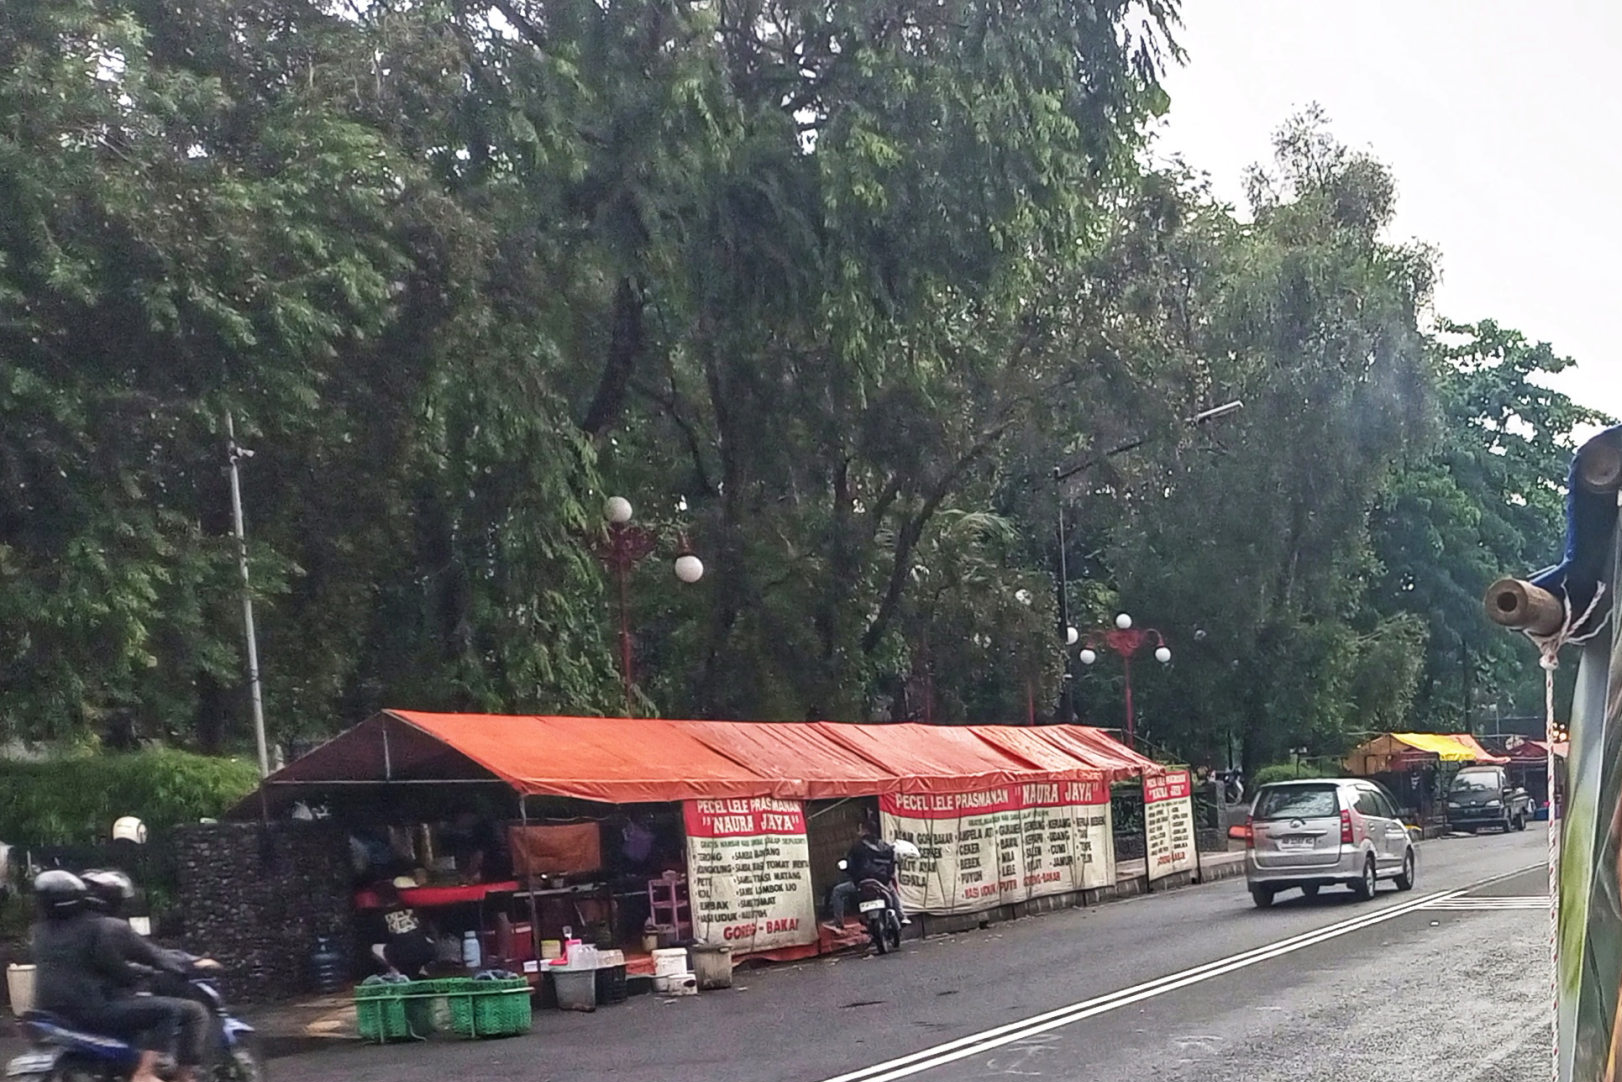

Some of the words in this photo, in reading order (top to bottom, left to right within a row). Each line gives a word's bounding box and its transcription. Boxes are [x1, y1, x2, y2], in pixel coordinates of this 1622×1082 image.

[697, 799, 727, 814] PECEL
[727, 799, 749, 814] LELE
[895, 793, 928, 810] PECEL
[931, 795, 954, 810] LELE
